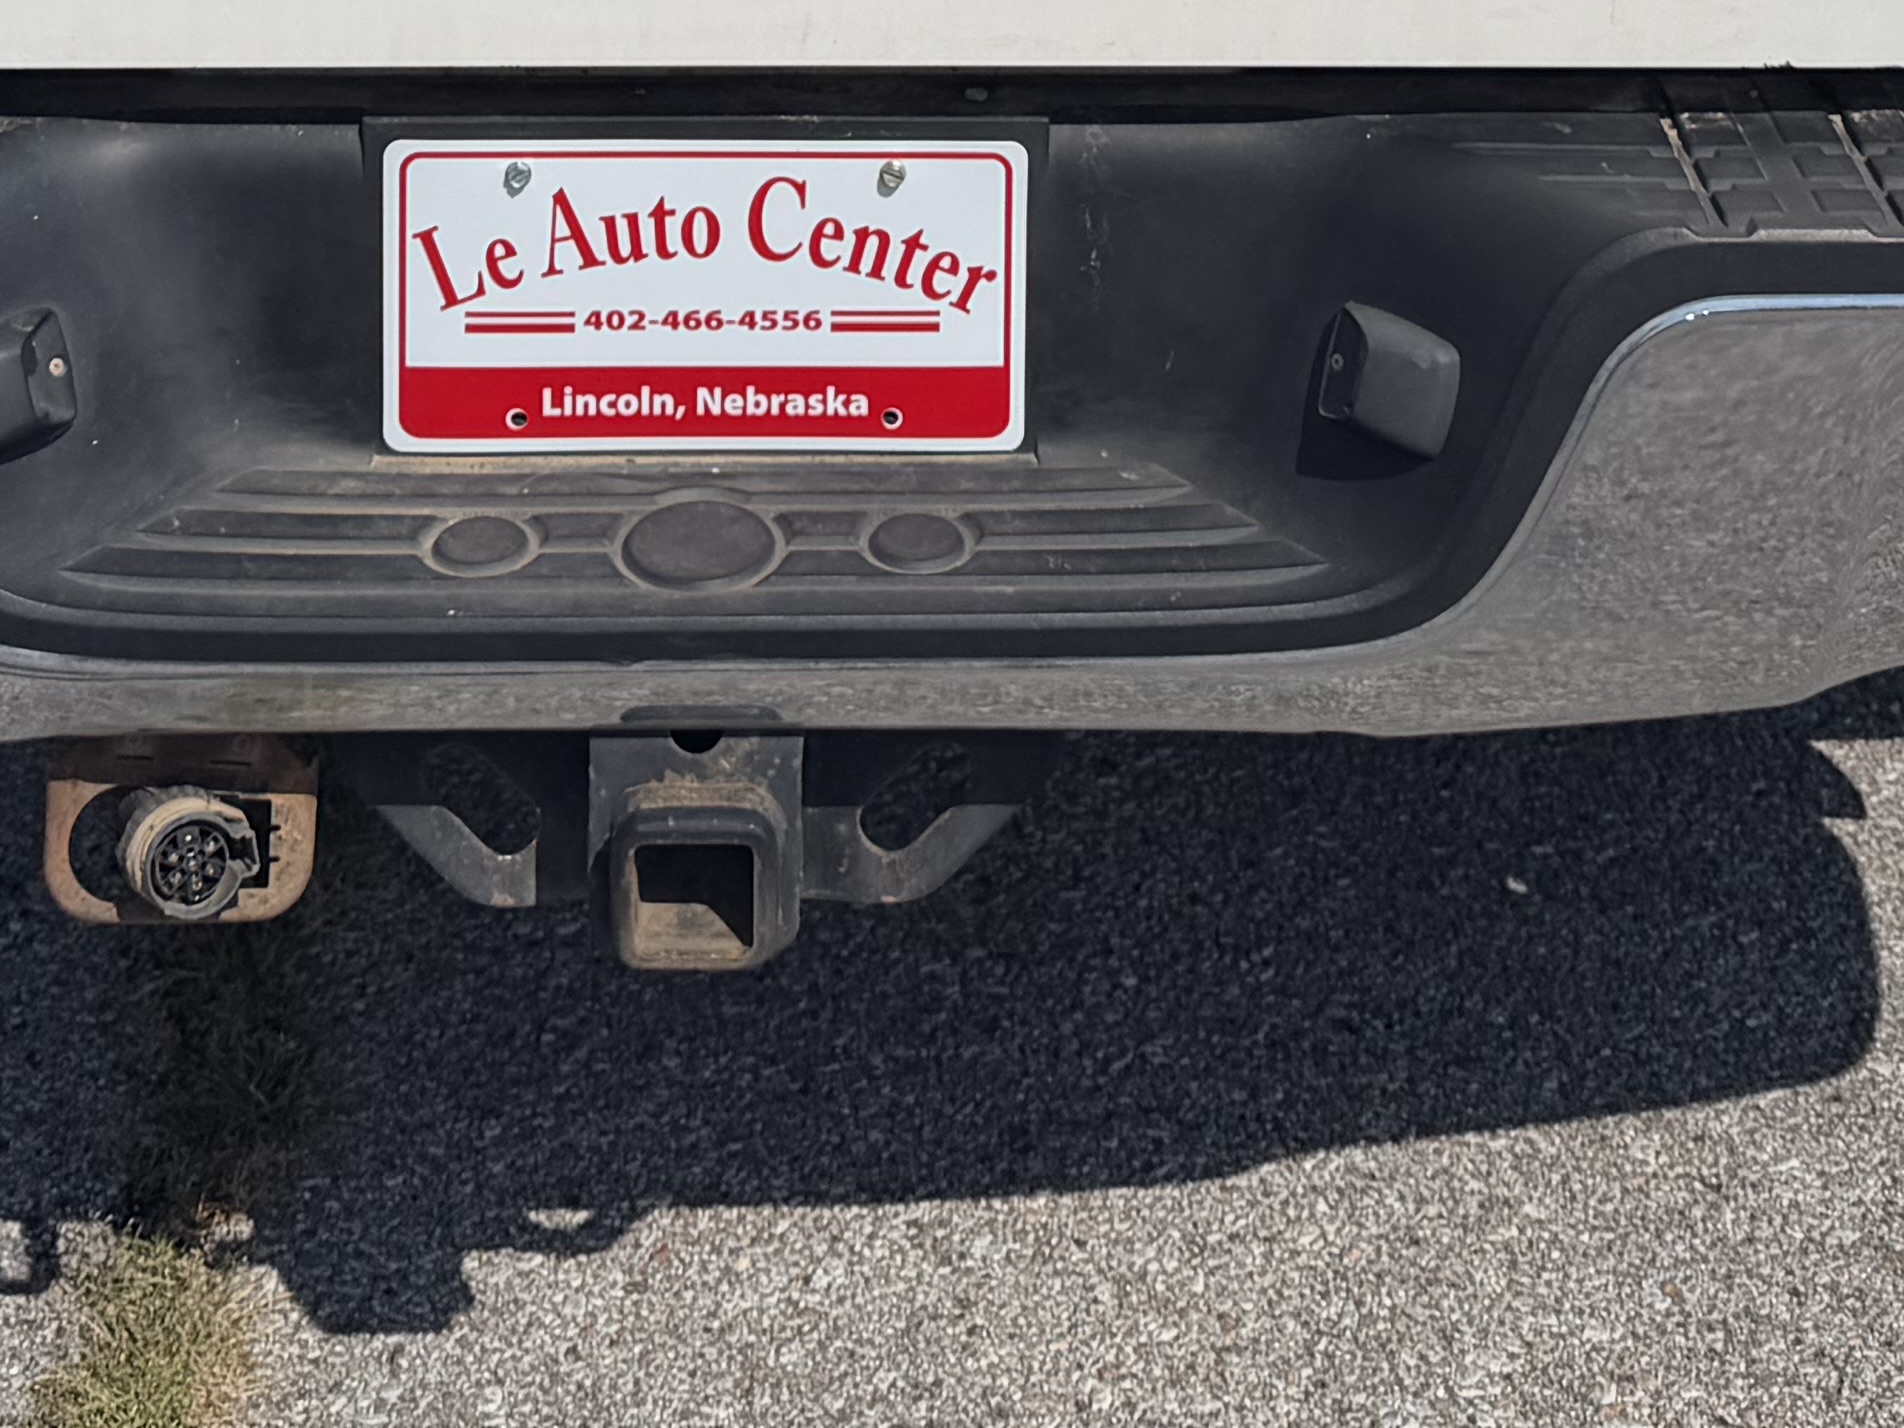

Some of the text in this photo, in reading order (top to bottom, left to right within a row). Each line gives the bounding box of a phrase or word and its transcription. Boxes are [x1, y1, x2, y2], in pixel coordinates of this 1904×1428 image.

[413, 176, 998, 314] Le Auto Center
[583, 309, 823, 332] 402-466-4556
[542, 384, 869, 420] Lincoln, Nebraska
